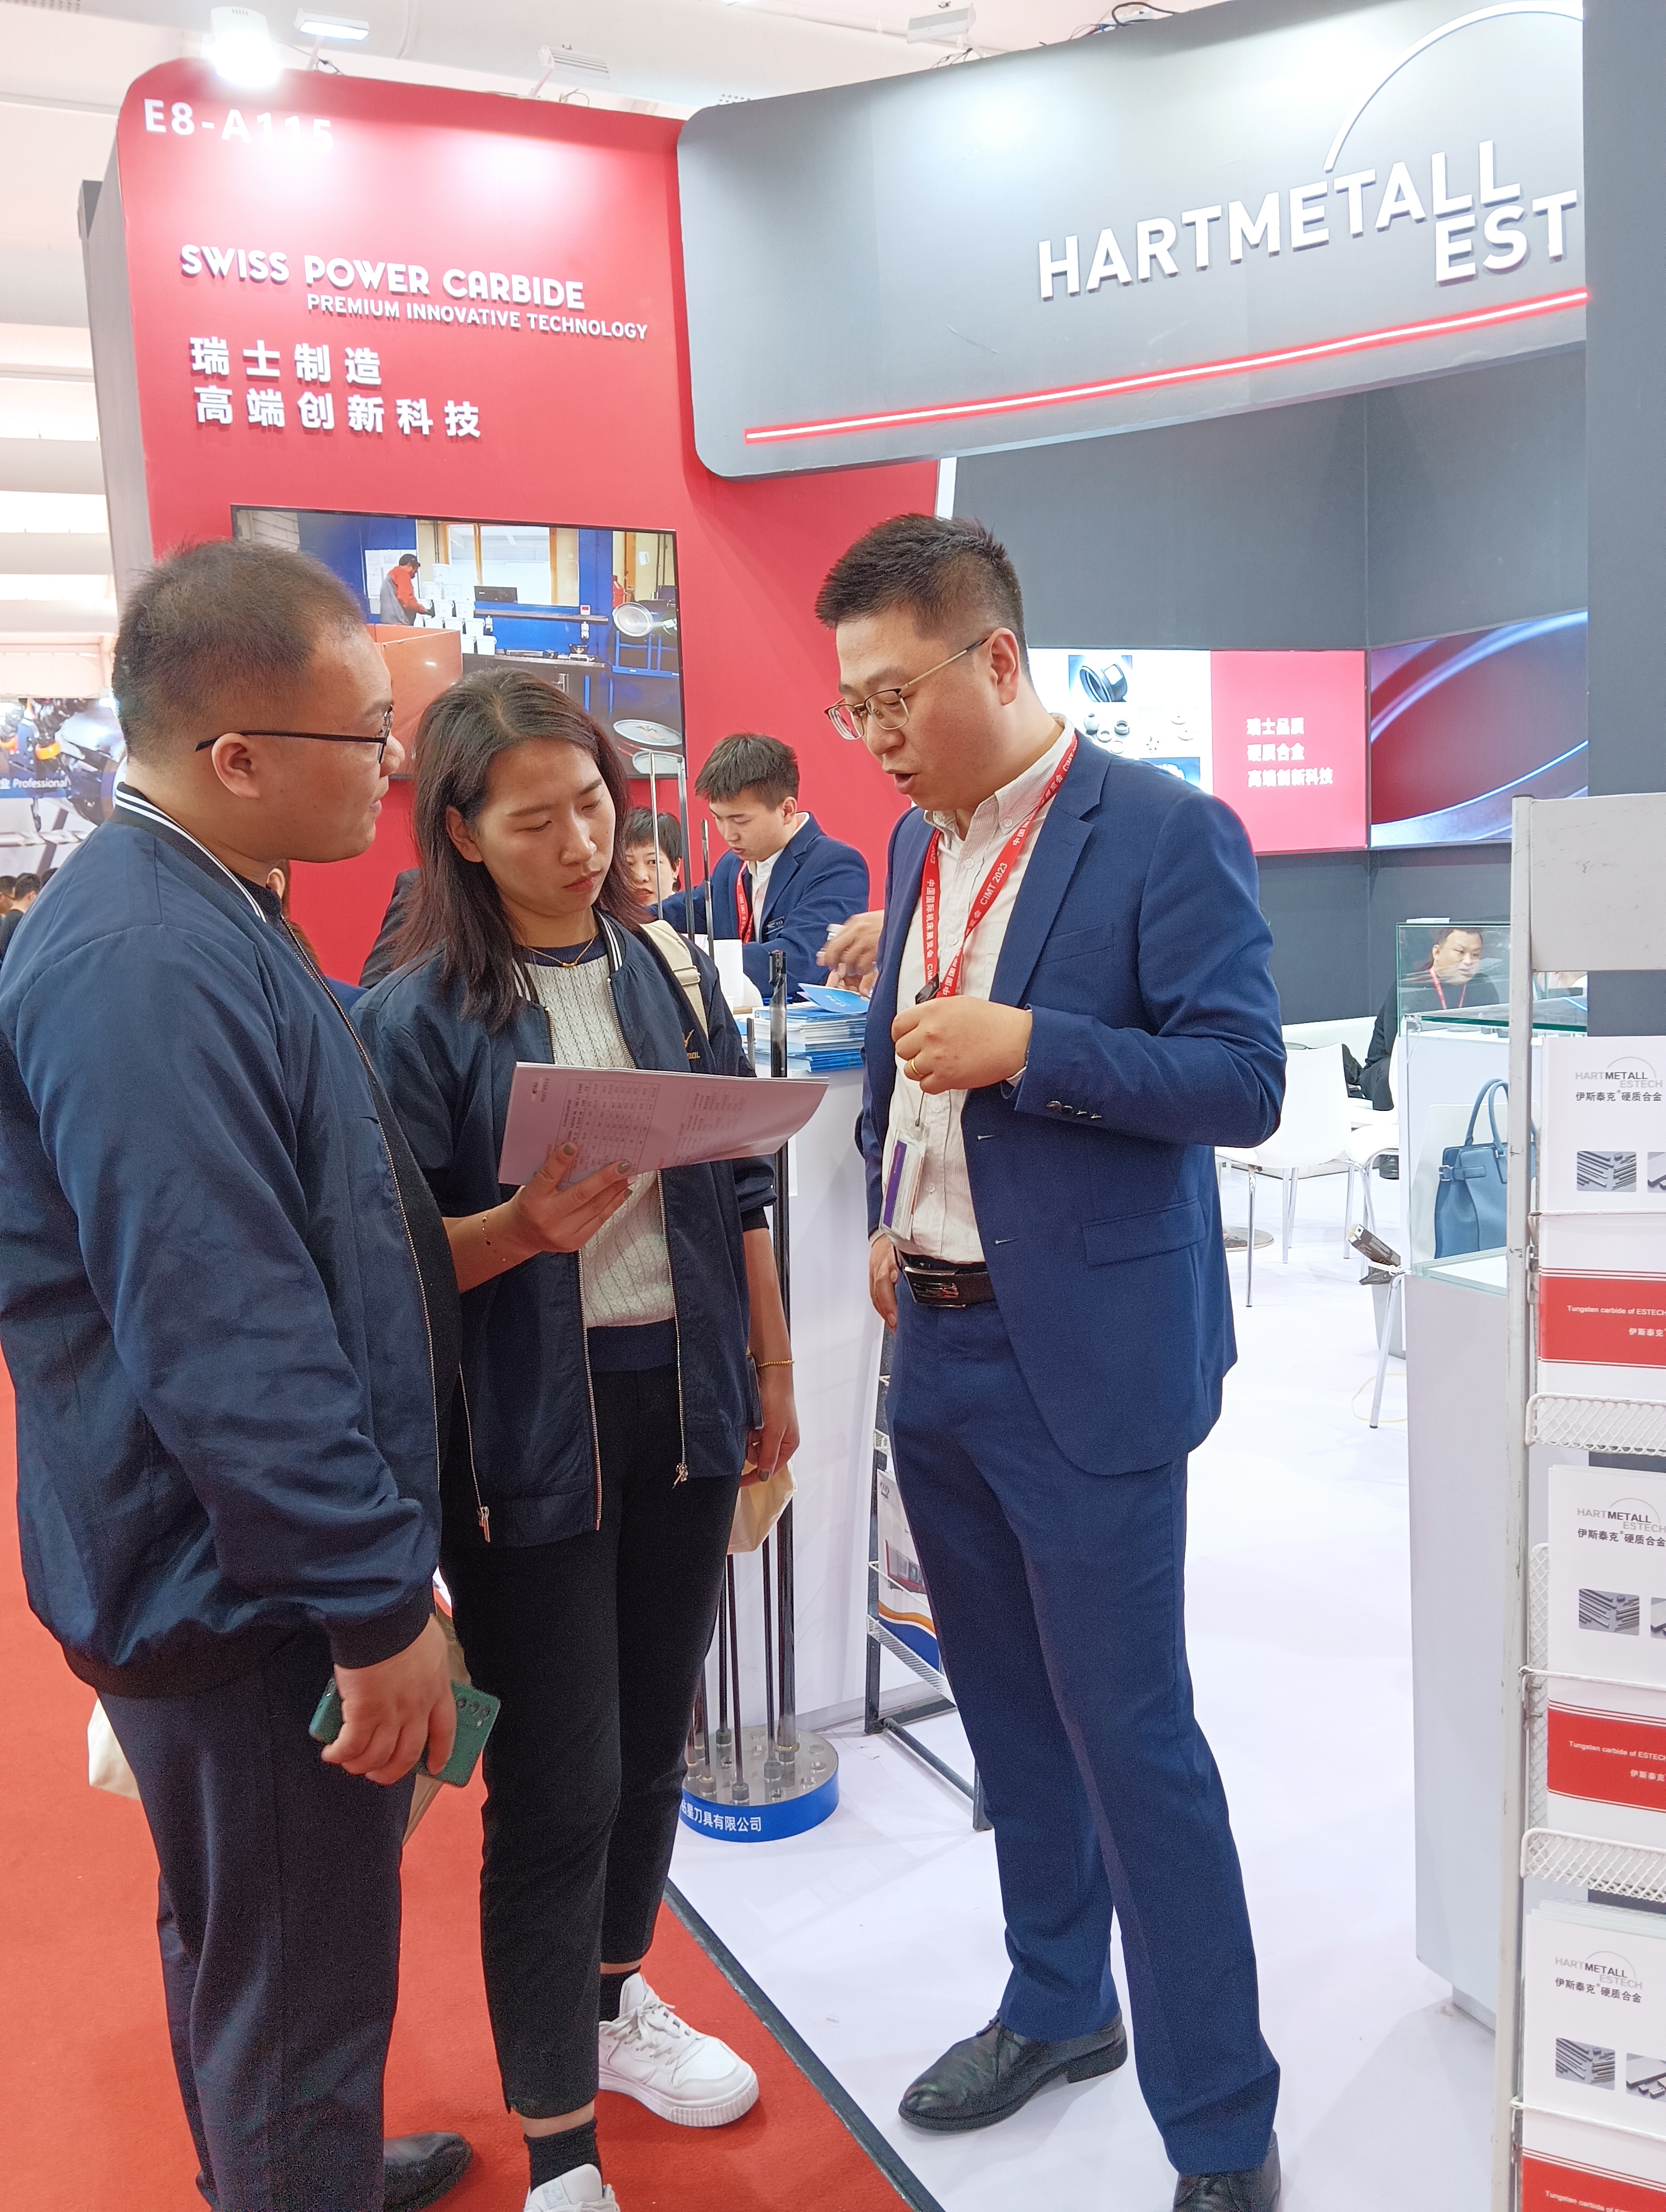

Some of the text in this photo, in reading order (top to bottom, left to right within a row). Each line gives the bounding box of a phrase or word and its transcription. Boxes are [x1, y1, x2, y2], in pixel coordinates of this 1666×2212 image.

[144, 98, 334, 152] E8-A115
[1038, 140, 1521, 301] HARTMETALL
[181, 245, 585, 310] SWISS POWER CARBIDE
[307, 294, 648, 340] PREMIUM INNOVATIVE TECHNOLOGY
[190, 336, 382, 386] 瑞士制造
[194, 385, 482, 439] 高端创新科技
[12, 776, 68, 788] Professional
[981, 883, 996, 905] CIMT
[992, 863, 1008, 883] 2023
[926, 879, 935, 958] 中国国际机床展览会
[1575, 1071, 1648, 1080] HARTMETALL
[1620, 1080, 1663, 1088] ESTECH
[1567, 1305, 1599, 1314] Tungsten
[1577, 1508, 1652, 1523] HARTMETALL
[1623, 1521, 1666, 1533] ESTECH
[1569, 1740, 1600, 1752] Tungsten
[1601, 1746, 1628, 1756] carbide
[1554, 1956, 1628, 1978] HARTMETALL
[1599, 1973, 1643, 1990] ESTECH
[1545, 2190, 1578, 2204] Tungsten
[1578, 2200, 1605, 2211] carbide
